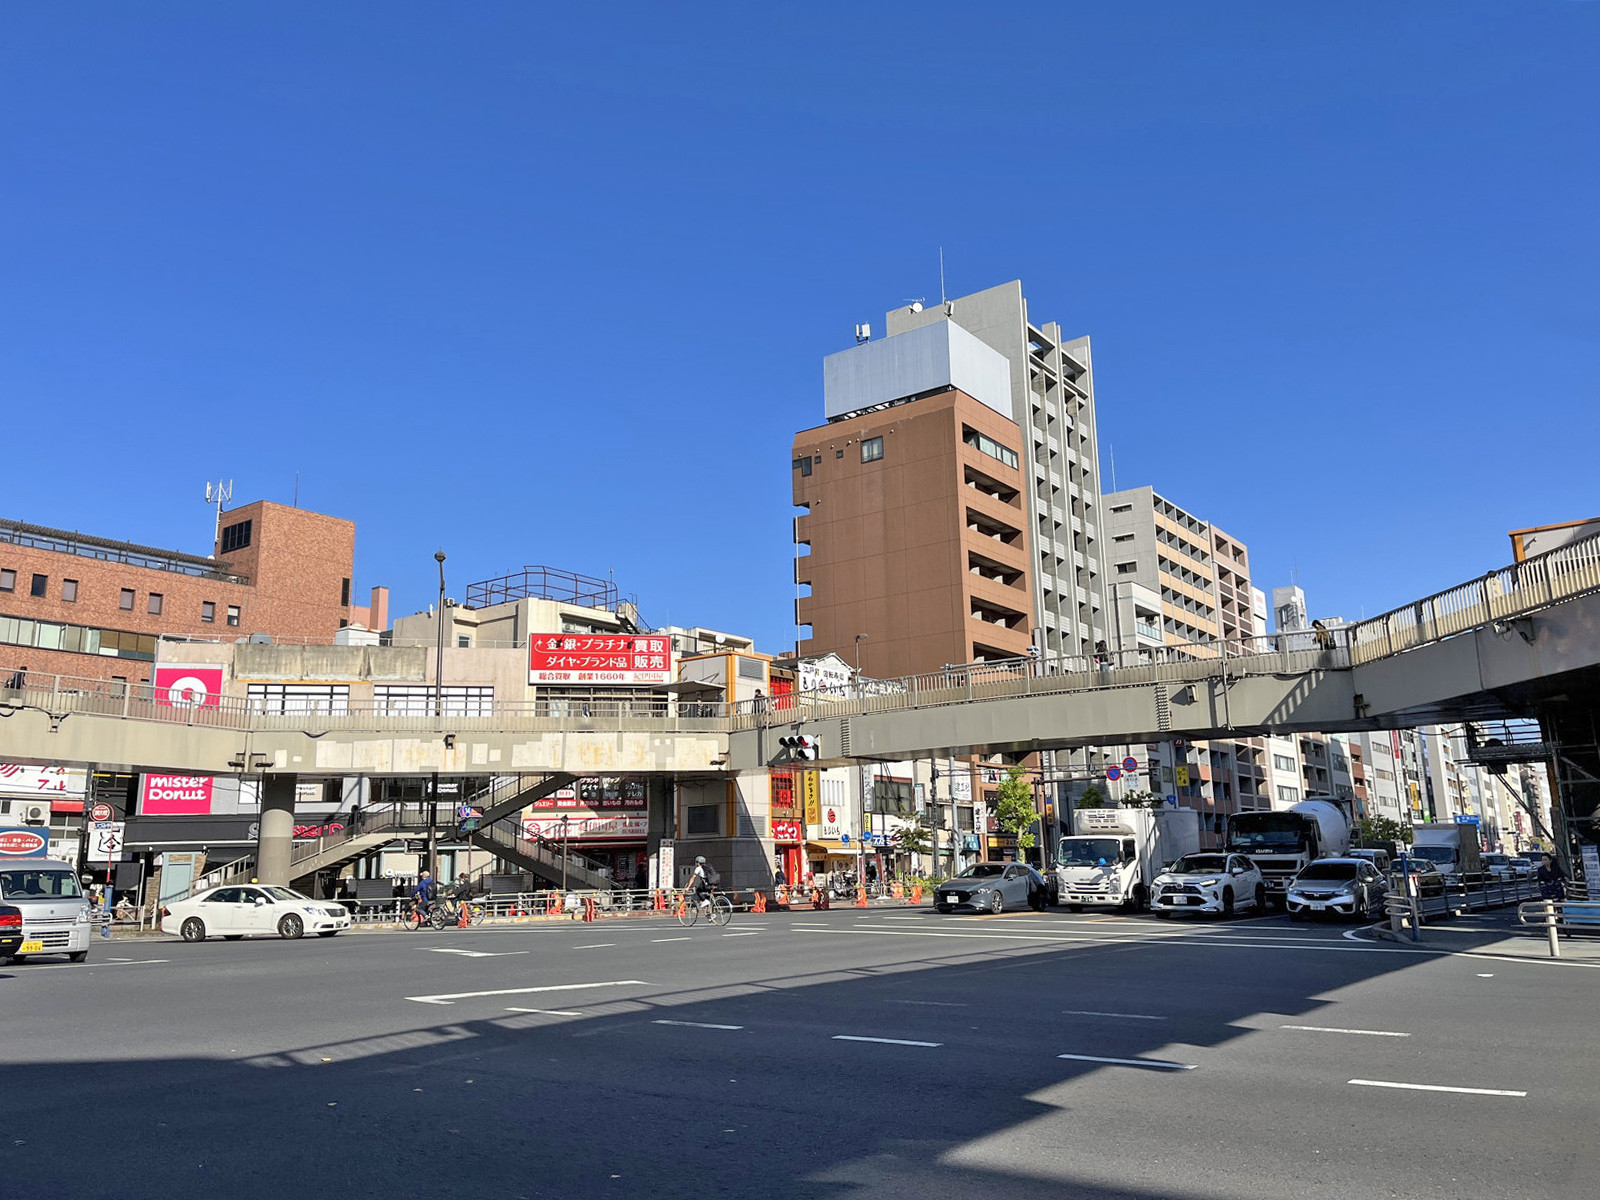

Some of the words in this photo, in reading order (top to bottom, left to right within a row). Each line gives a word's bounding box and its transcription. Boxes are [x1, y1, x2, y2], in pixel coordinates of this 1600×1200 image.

[546, 637, 628, 650] 金・銀・プラチナ
[634, 639, 664, 653] 買取
[546, 656, 628, 668] ダイヤ・ブランド品
[634, 655, 664, 669] 販売
[538, 672, 571, 680] 総合買取
[578, 672, 626, 680] 創業1660年
[148, 788, 207, 800] Donut
